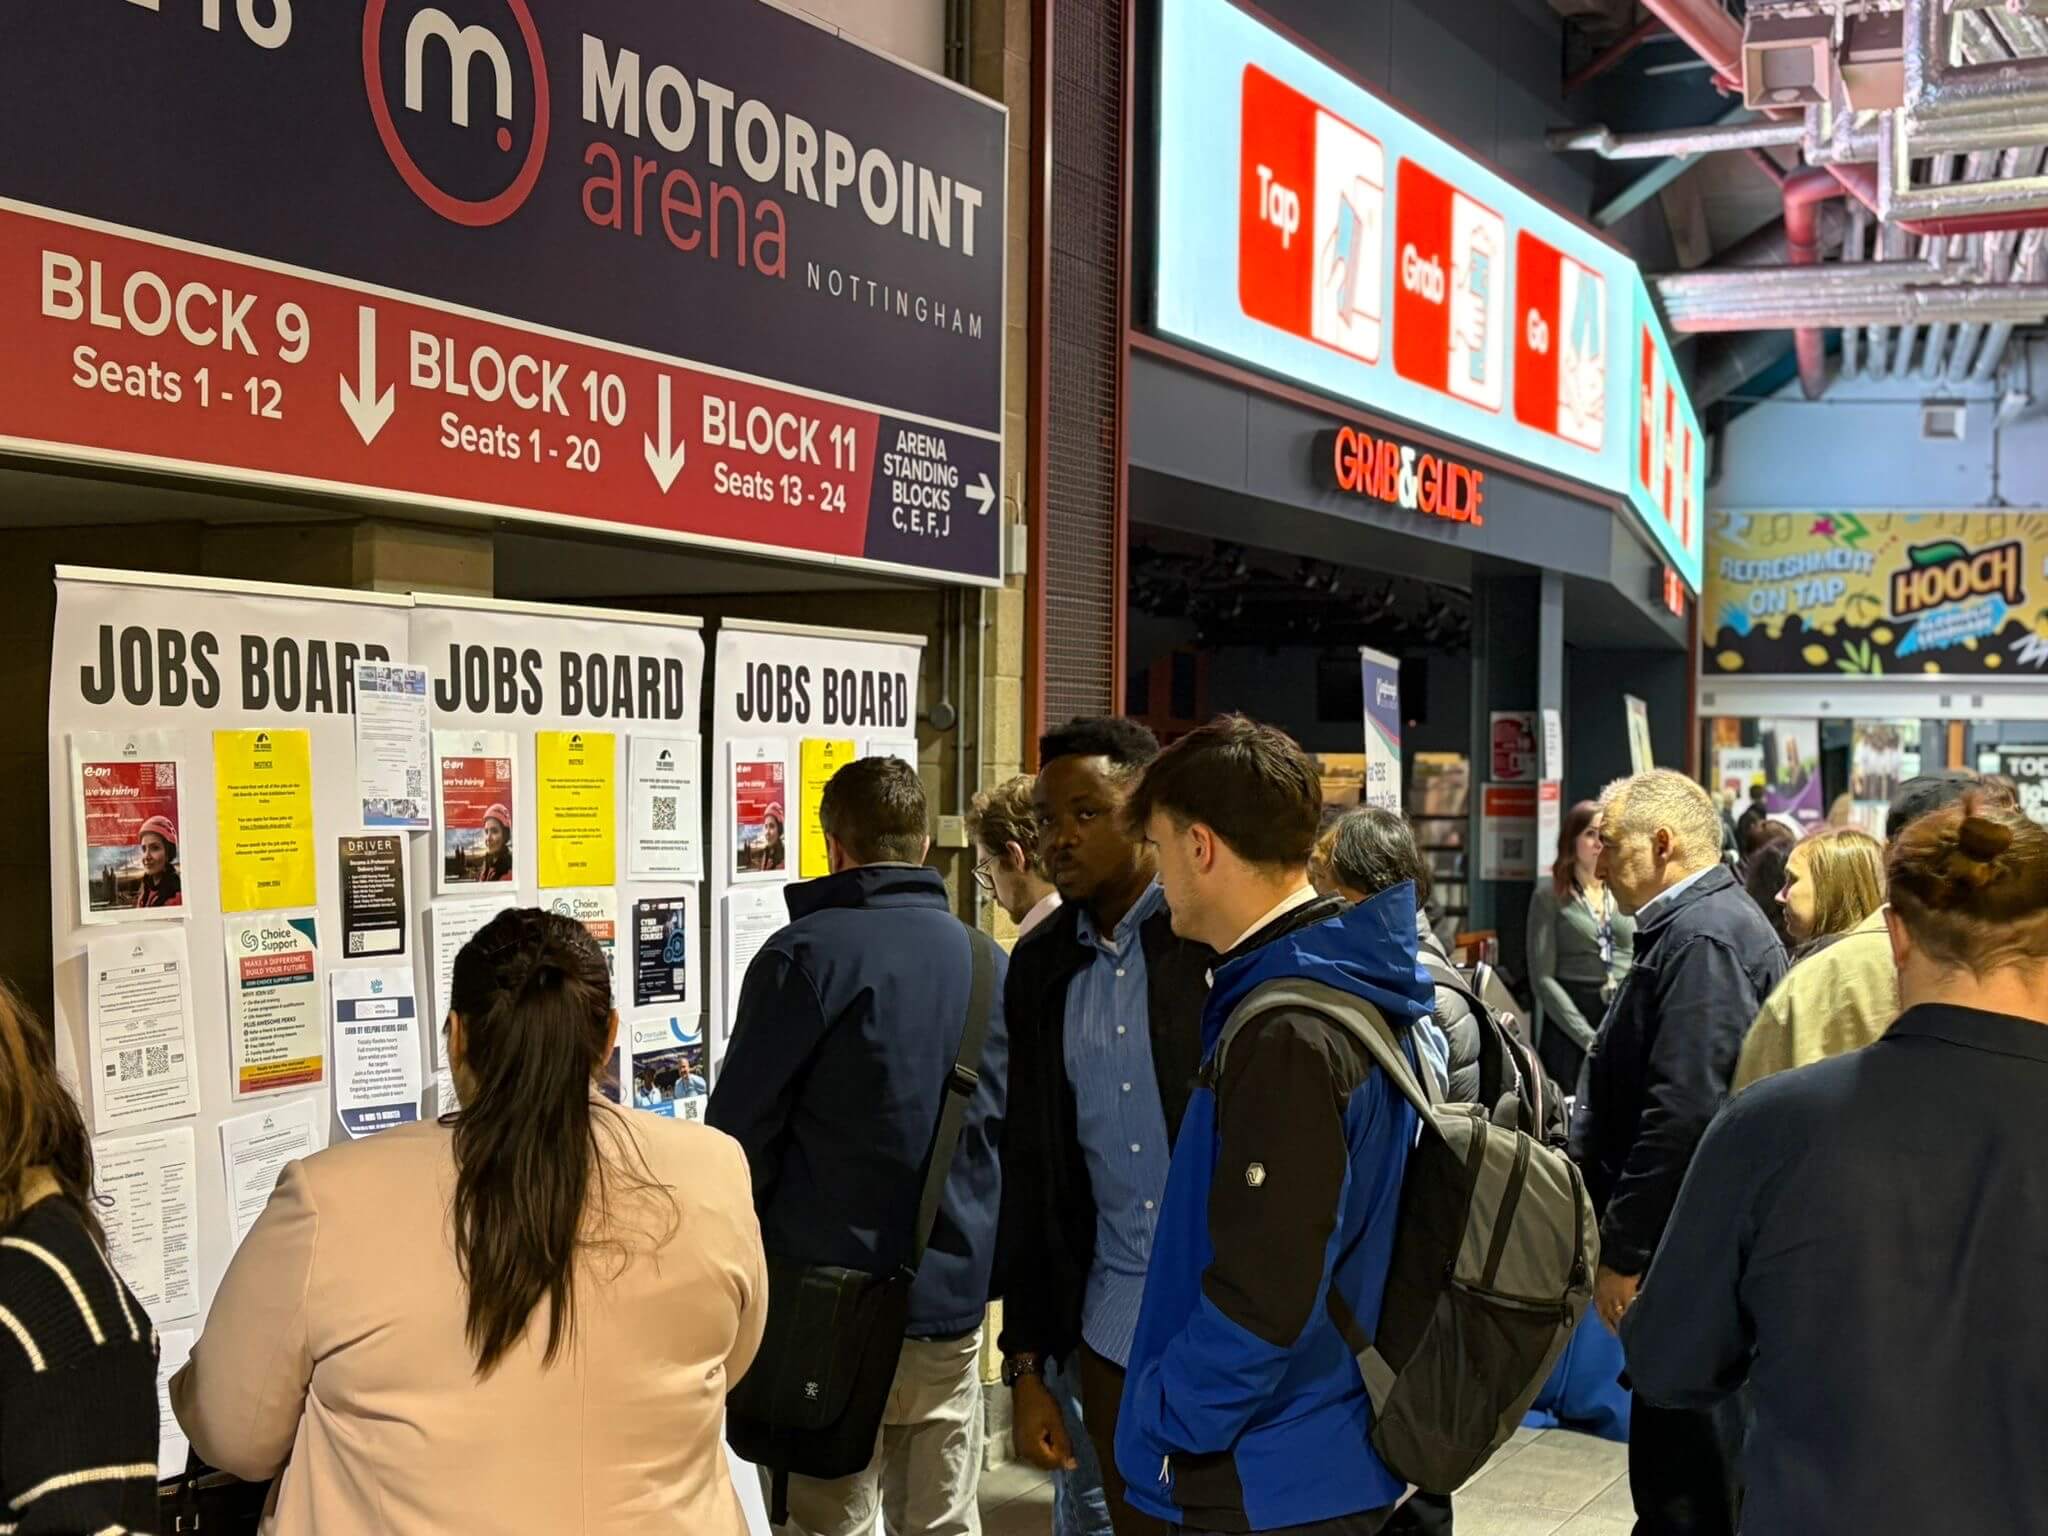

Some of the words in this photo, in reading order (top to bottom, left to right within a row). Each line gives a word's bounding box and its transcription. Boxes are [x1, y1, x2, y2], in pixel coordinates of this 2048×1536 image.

[582, 33, 982, 256] MOTORPOINT
[582, 142, 787, 279] arena
[1255, 164, 1300, 250] Tap
[807, 261, 982, 340] NOTTINGHAM
[1402, 243, 1445, 305] Grab
[41, 249, 259, 357] BLOCK
[275, 301, 311, 364] 9
[1526, 308, 1550, 355] Go
[72, 344, 182, 402] Seats
[193, 367, 210, 407] 1
[244, 378, 283, 420] 12
[409, 329, 571, 417] BLOCK
[581, 370, 627, 427] 10
[440, 411, 521, 461] Seats
[529, 428, 542, 464] 1
[566, 434, 600, 473] 20
[702, 395, 821, 465] BLOCK
[829, 424, 857, 473] 11
[896, 430, 947, 461] ARENA
[714, 462, 774, 502] Seats
[779, 473, 803, 505] 13
[820, 480, 847, 514] 24
[883, 454, 958, 488] STANDING
[892, 481, 950, 512] BLOCKS
[892, 507, 907, 535] C,
[911, 511, 925, 536] E,
[927, 513, 940, 538] F,
[941, 513, 950, 537] J
[1720, 546, 1875, 584] REFRESHMENT
[1895, 546, 2017, 612] HOOCH
[1749, 588, 1787, 616] ON
[1794, 577, 1845, 611] TAP
[80, 624, 221, 709] JOBS
[241, 634, 390, 715] BOAR
[434, 643, 544, 716] JOBS
[560, 651, 684, 720] BOARD
[736, 662, 811, 724] JOBS
[823, 667, 908, 727] BOARD
[348, 840, 392, 851] DRIVER
[573, 898, 599, 909] Choice
[573, 909, 604, 918] Support
[261, 928, 291, 939] Choice
[262, 939, 298, 952] Support
[244, 959, 261, 967] MAKE
